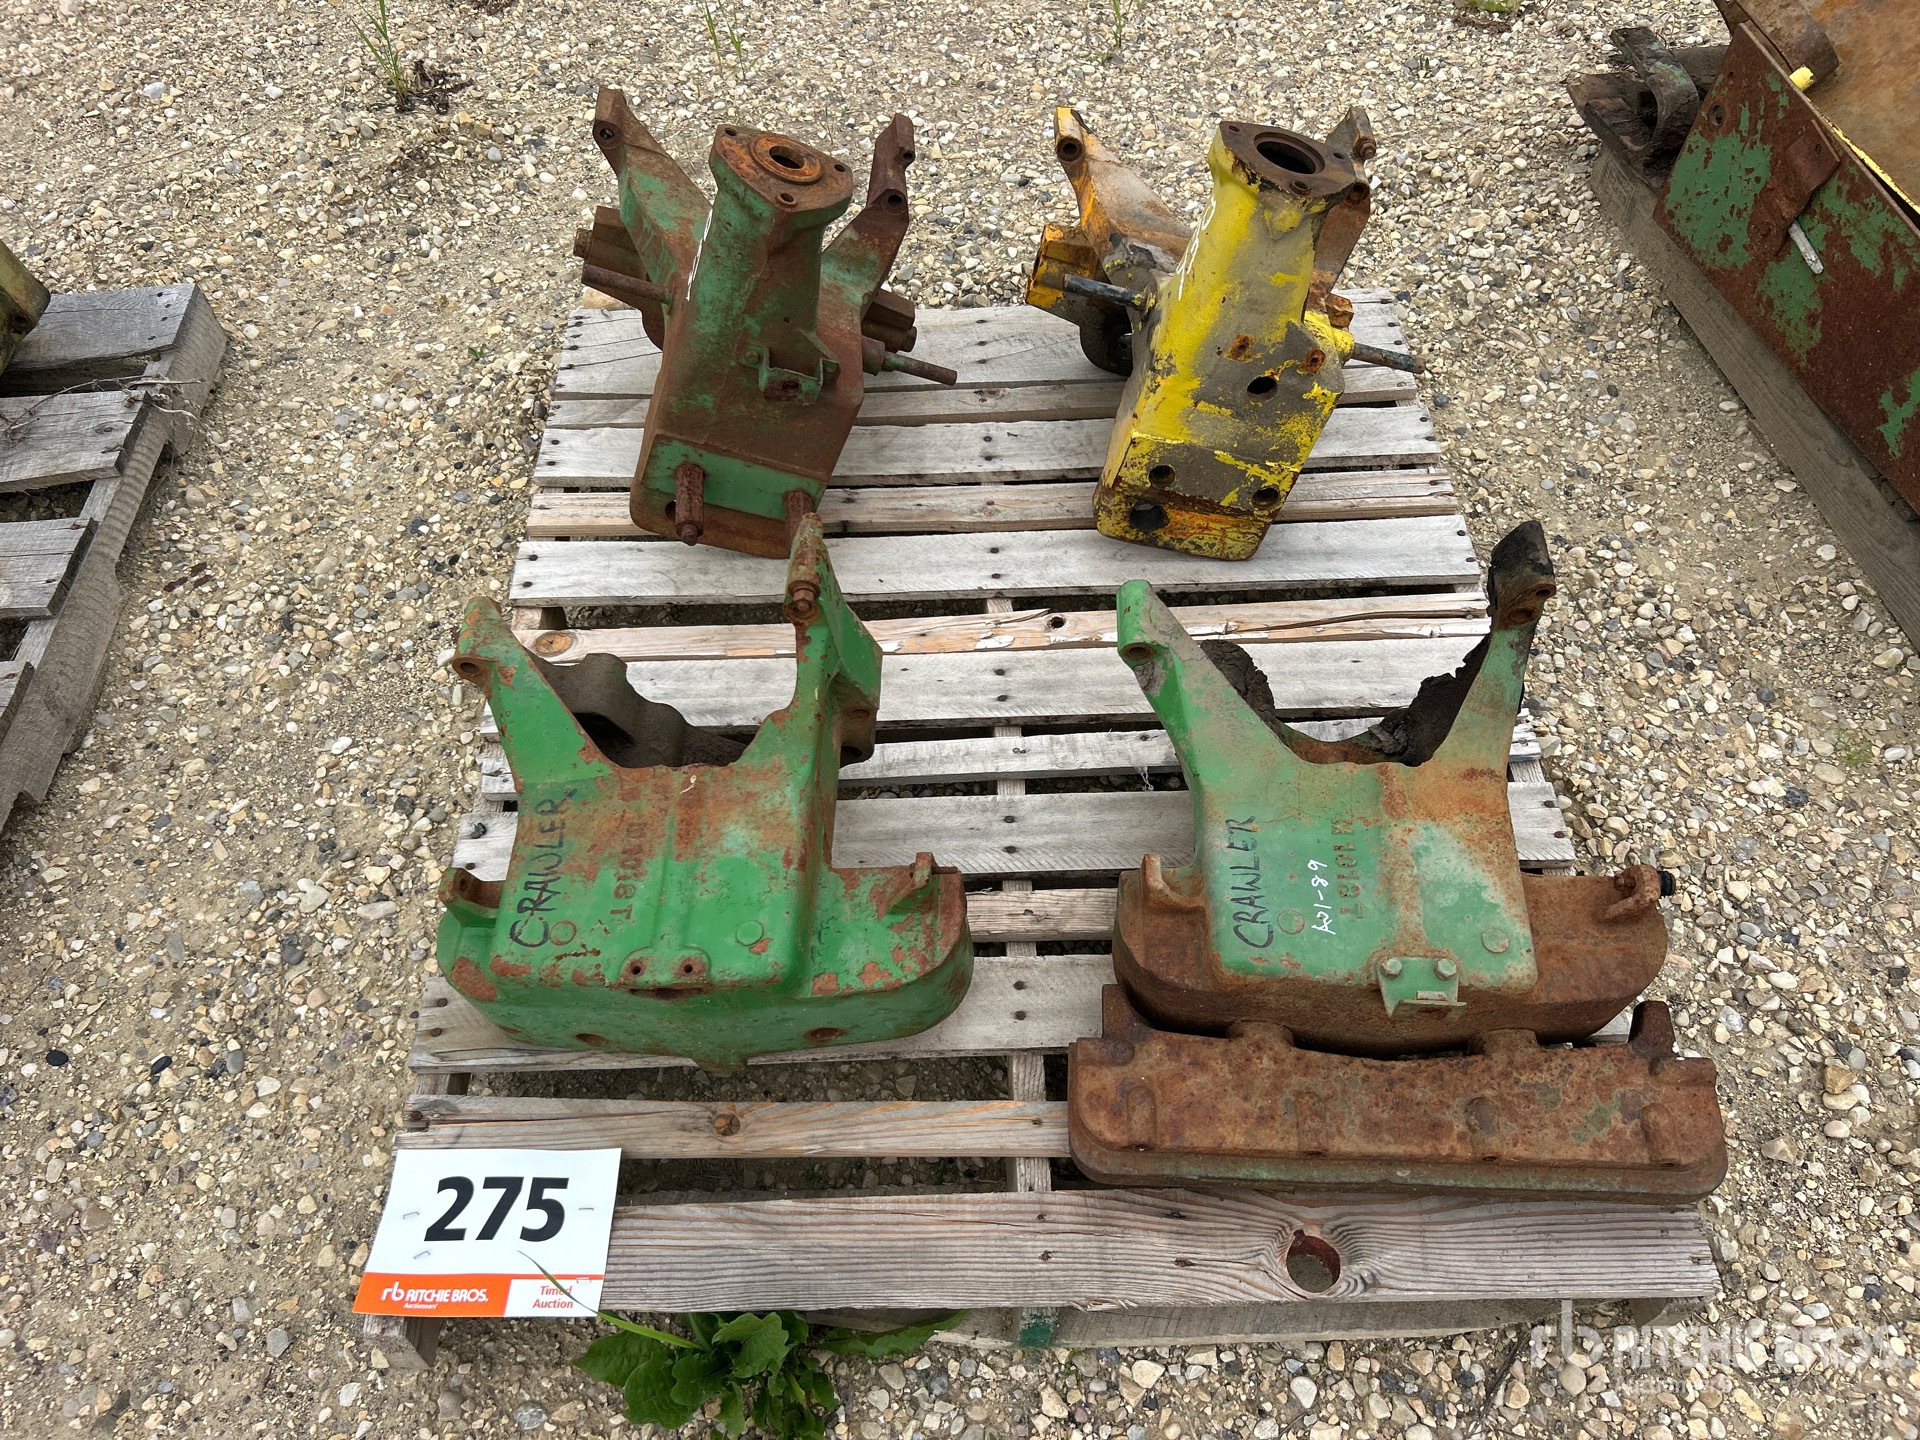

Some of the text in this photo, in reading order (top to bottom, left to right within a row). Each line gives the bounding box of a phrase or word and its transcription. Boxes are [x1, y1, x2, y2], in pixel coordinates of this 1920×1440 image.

[509, 788, 577, 948] CRAWLER
[1225, 815, 1274, 949] CRAWLER
[424, 1176, 570, 1242] 275
[405, 1288, 451, 1302] RITCHIE
[451, 1288, 489, 1302] BROS.
[532, 1298, 574, 1309] Auction
